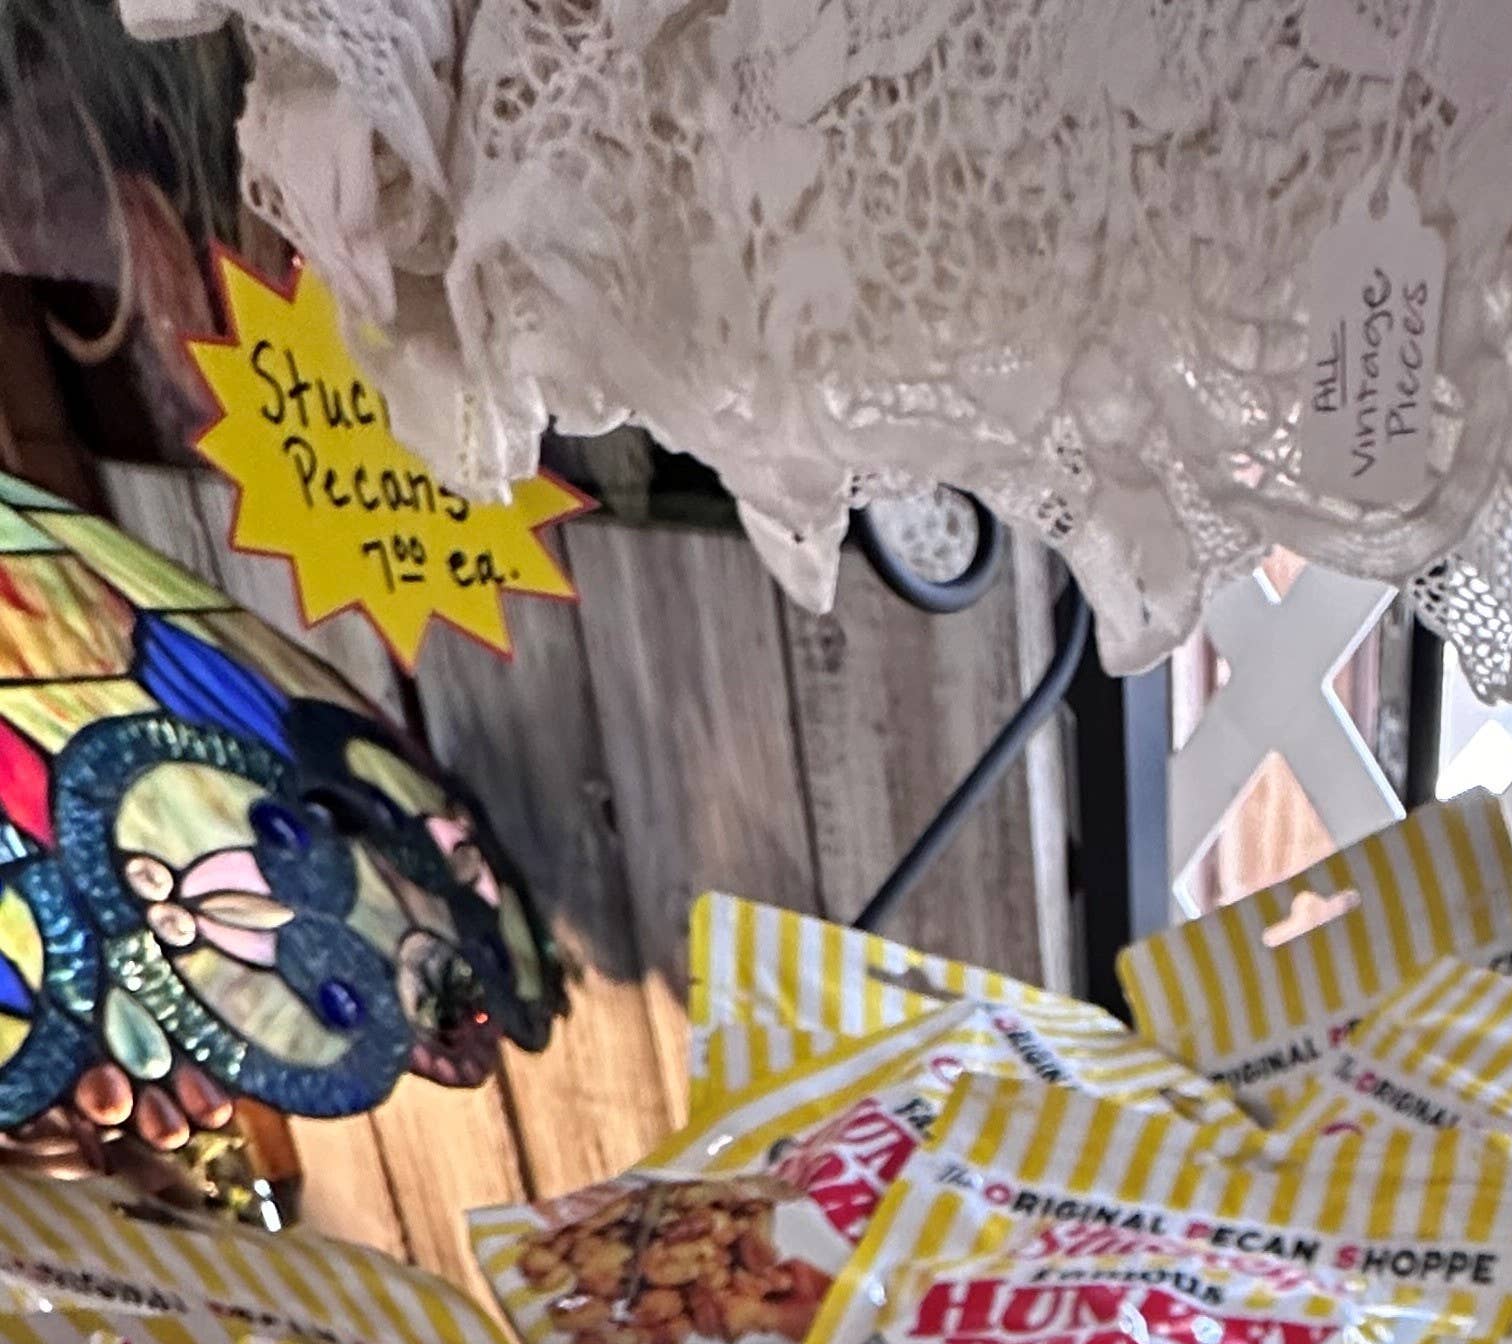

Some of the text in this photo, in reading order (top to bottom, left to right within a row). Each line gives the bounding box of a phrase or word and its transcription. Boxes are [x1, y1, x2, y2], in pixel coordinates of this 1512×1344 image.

[251, 339, 391, 428] Stuc
[1314, 333, 1340, 412] ALL
[984, 1182, 1165, 1236] ORIGINAL
[1184, 1220, 1322, 1268] PECAN
[1335, 1243, 1497, 1285] SHOPPE
